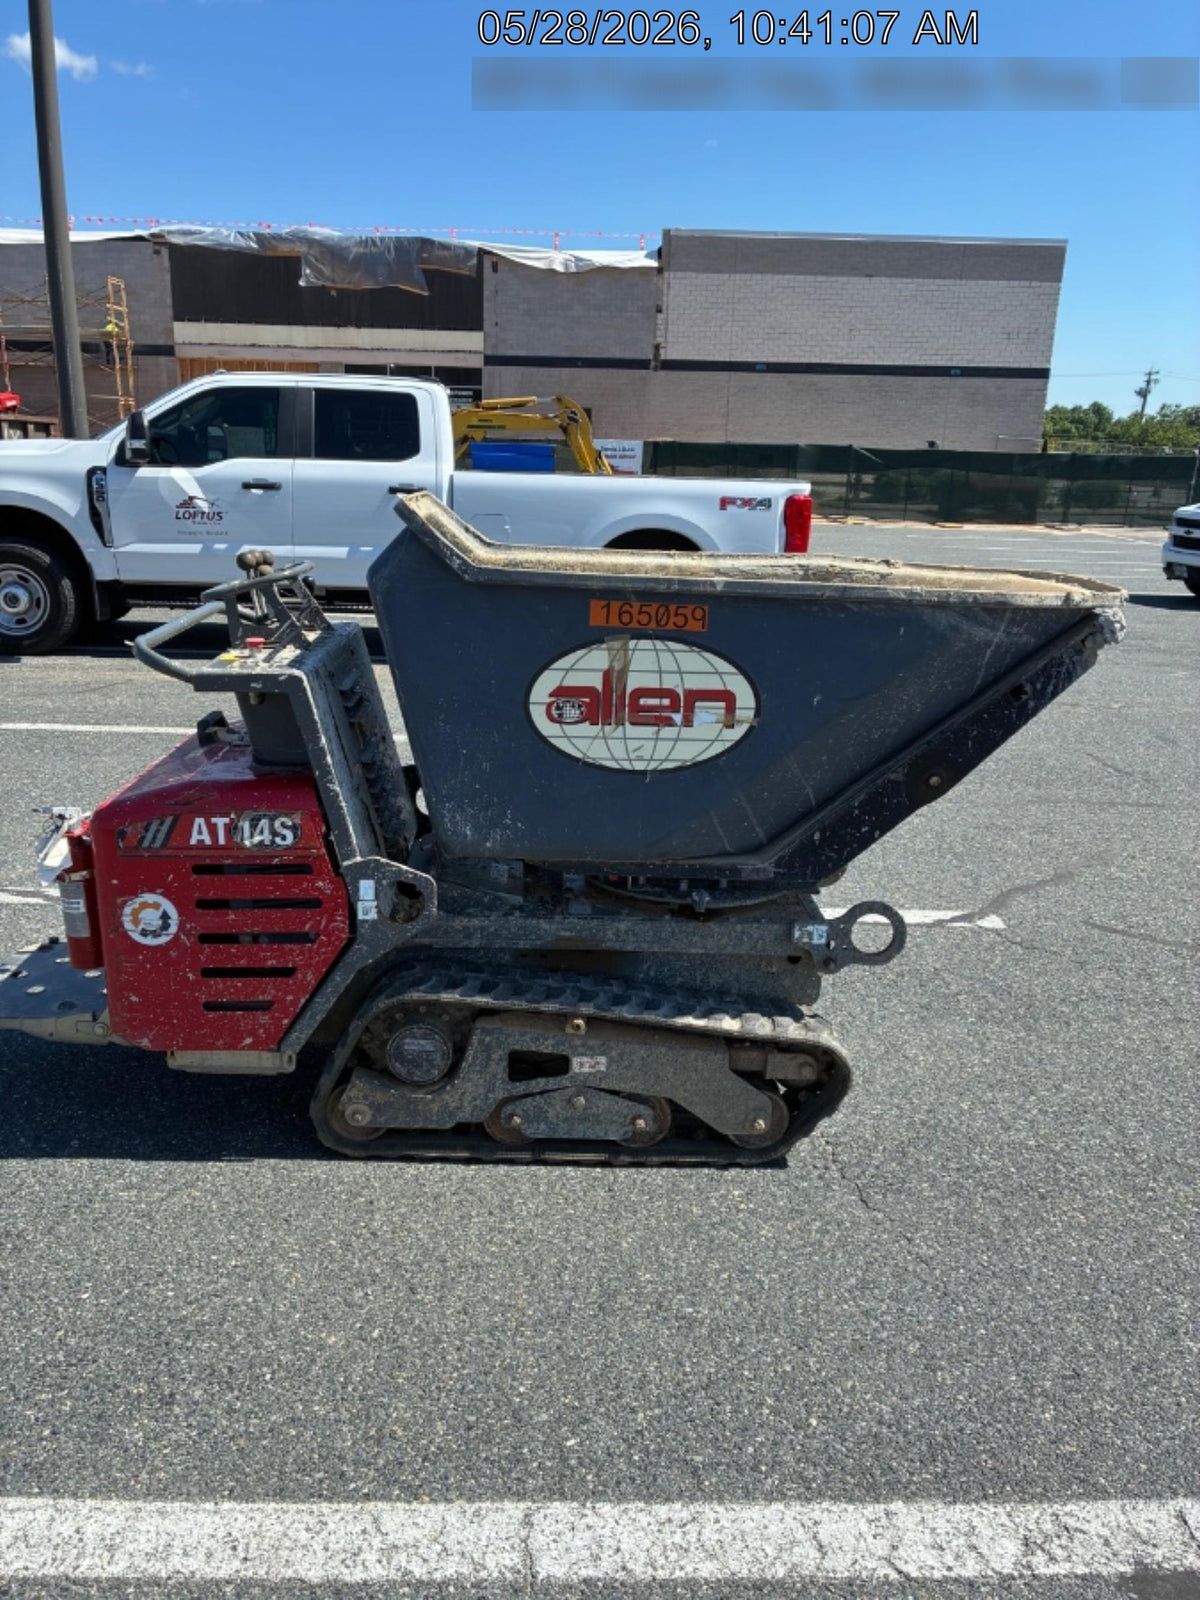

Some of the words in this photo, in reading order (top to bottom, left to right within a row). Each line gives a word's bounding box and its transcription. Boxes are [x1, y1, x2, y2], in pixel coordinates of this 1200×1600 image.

[719, 496, 772, 510] FX4
[175, 510, 223, 521] LOFTUS
[600, 601, 707, 630] 165059
[189, 817, 230, 845] AT
[242, 817, 294, 846] 14S
